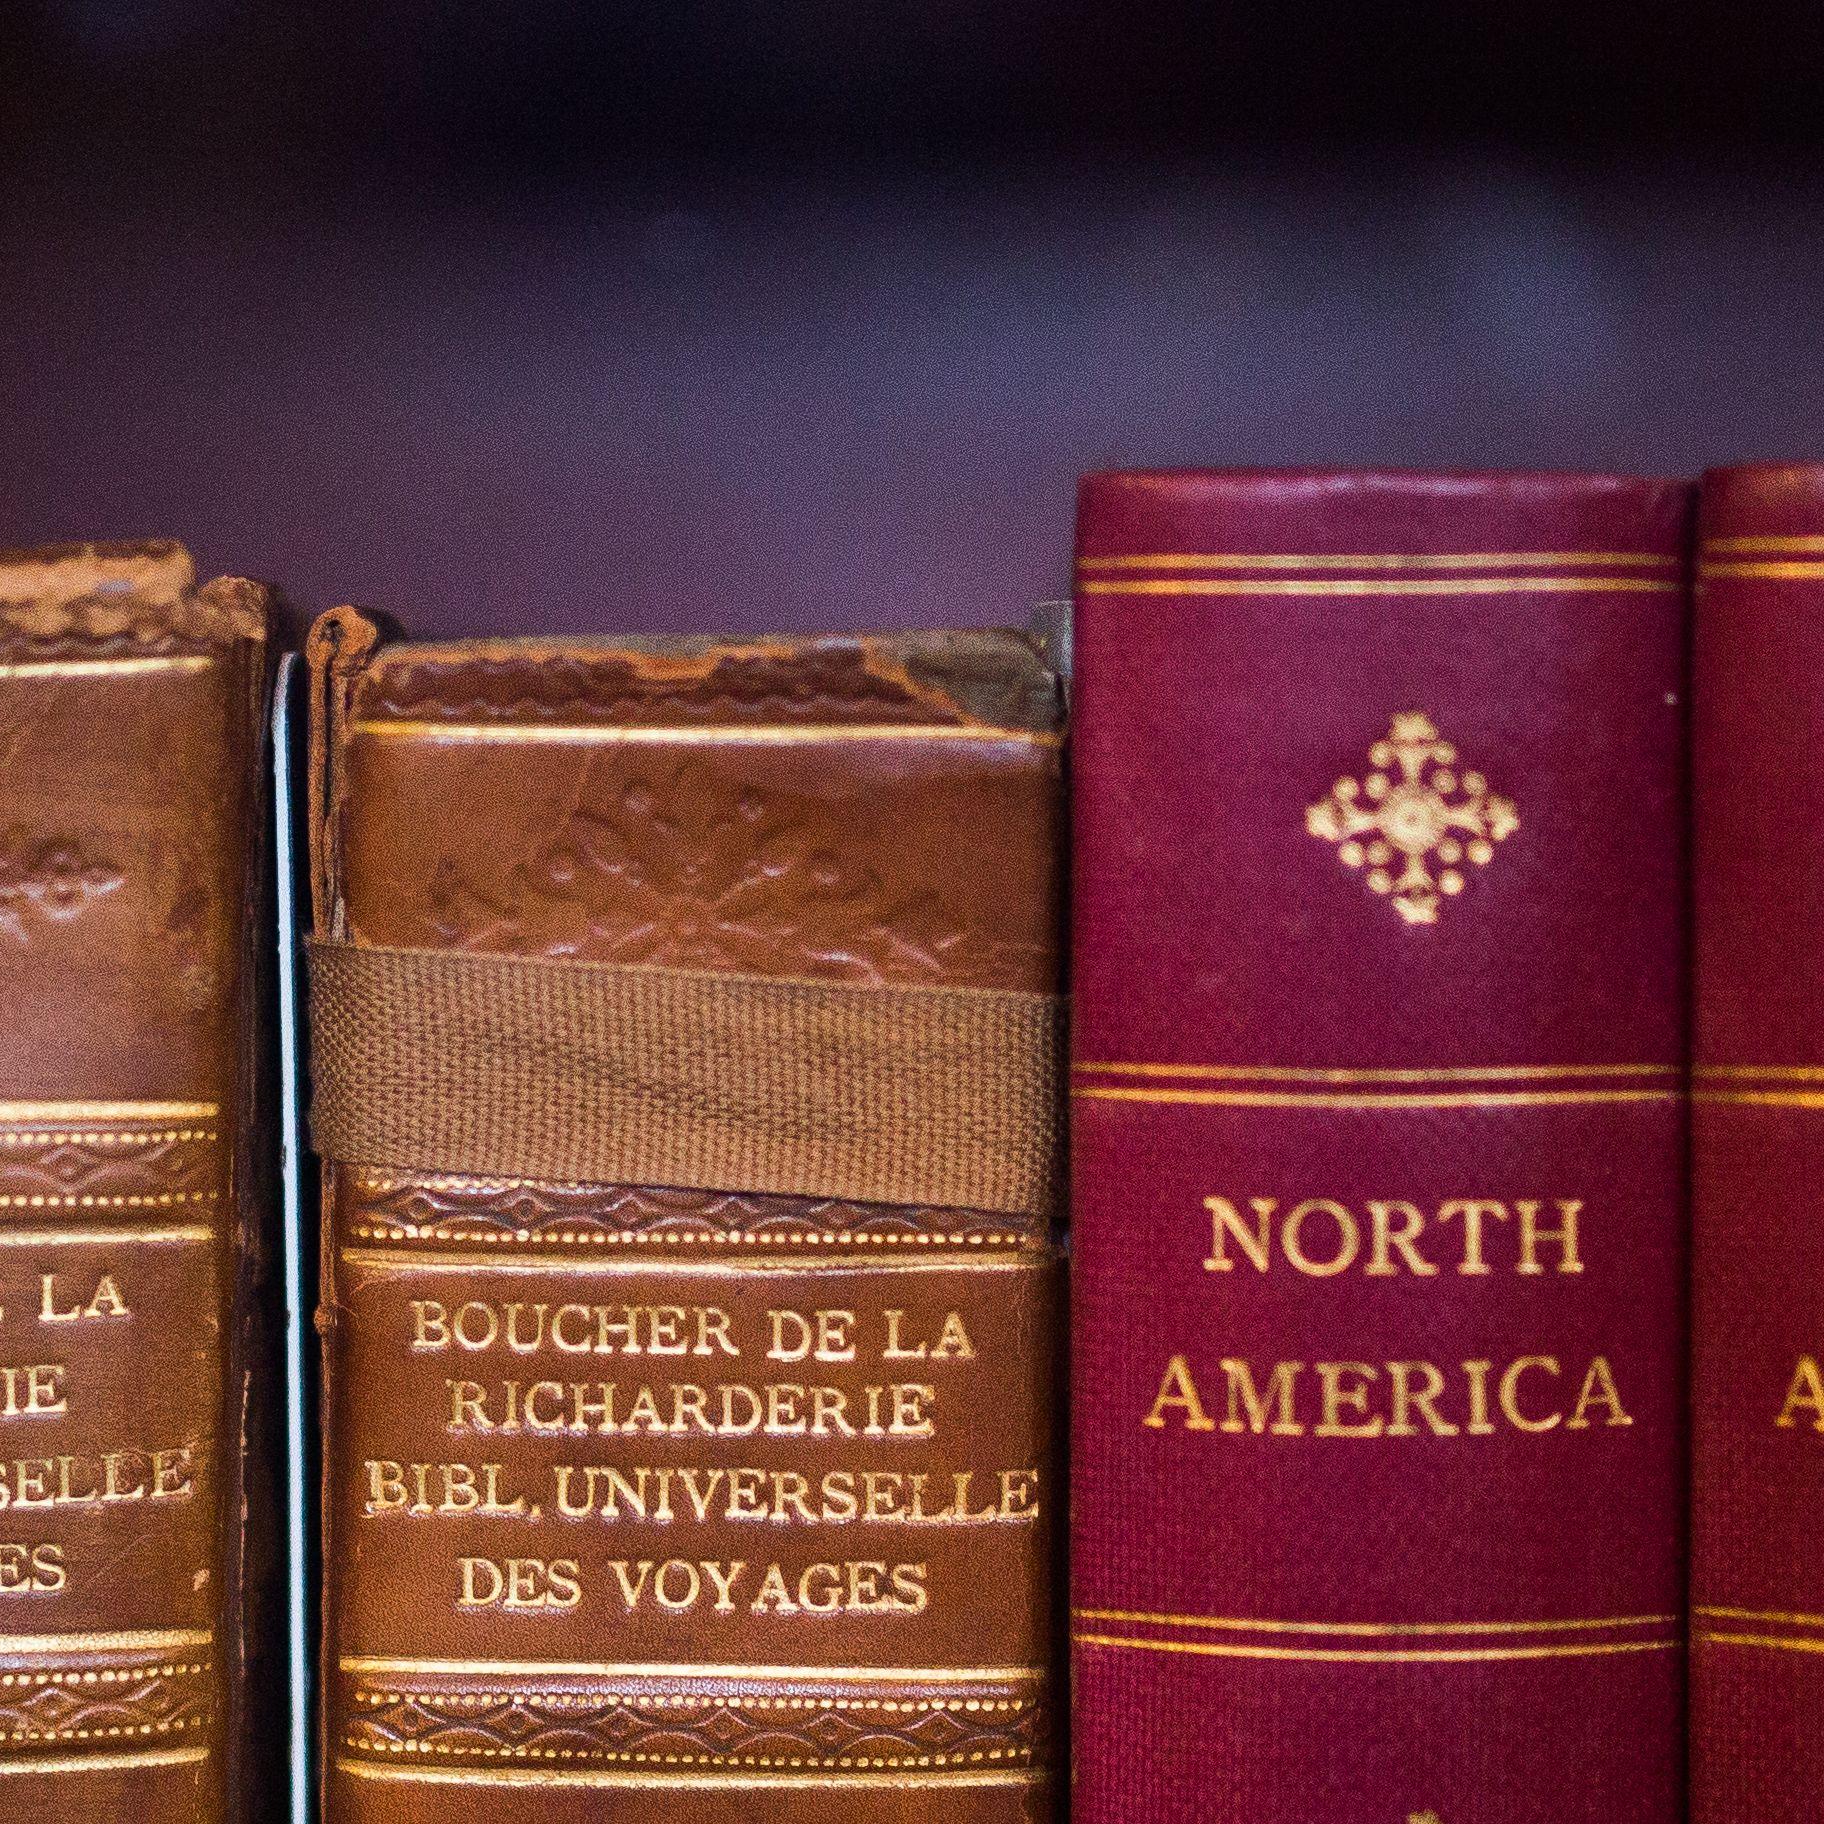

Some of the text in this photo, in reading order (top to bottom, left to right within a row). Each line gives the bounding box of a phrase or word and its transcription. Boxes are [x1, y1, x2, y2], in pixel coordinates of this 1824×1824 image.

[1202, 1195, 1584, 1278] NORTH
[39, 1273, 130, 1324] LA
[409, 1300, 976, 1363] BOUCHER DE LA
[445, 1377, 936, 1439] RICHARDERIE
[1143, 1354, 1634, 1439] AMERICA
[554, 1466, 1039, 1525] UNIVERSELLE
[457, 1557, 928, 1616] DES VOYAGES
